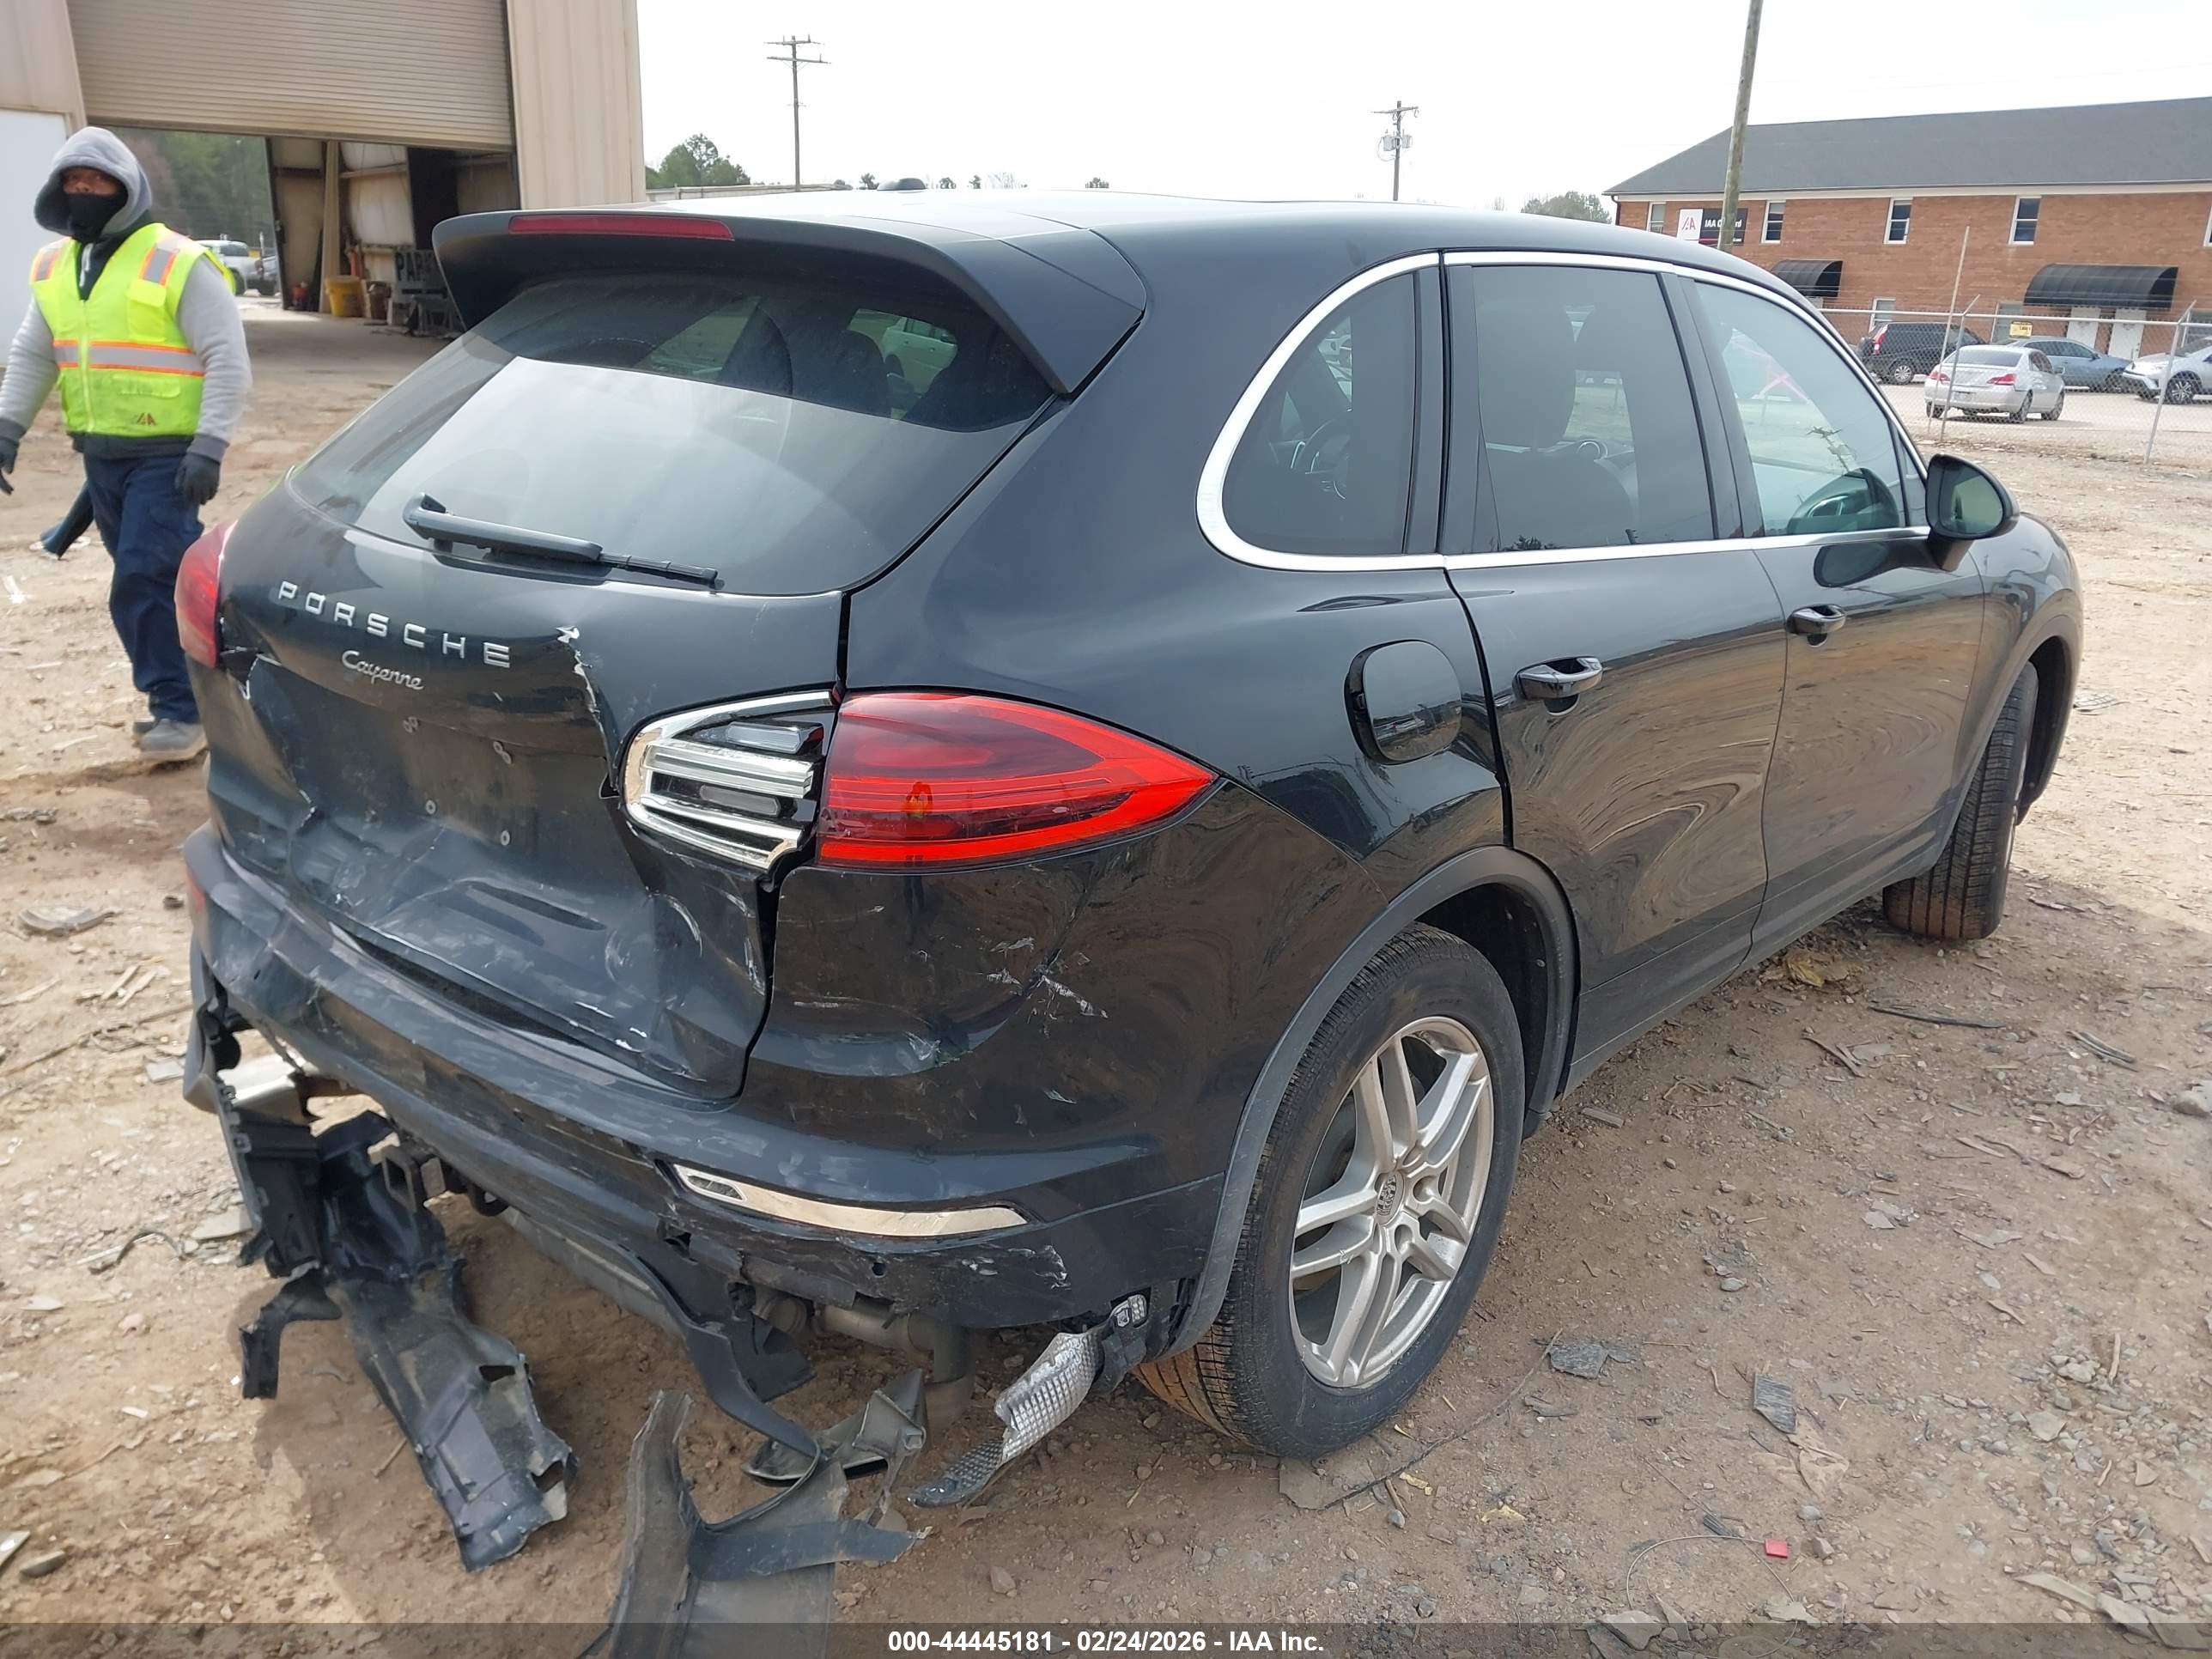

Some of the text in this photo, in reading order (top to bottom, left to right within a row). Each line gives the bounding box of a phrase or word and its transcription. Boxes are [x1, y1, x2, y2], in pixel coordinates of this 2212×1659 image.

[1705, 219, 1717, 228] IAA
[277, 580, 511, 668] PORSCHE
[341, 650, 425, 691] Cayenne
